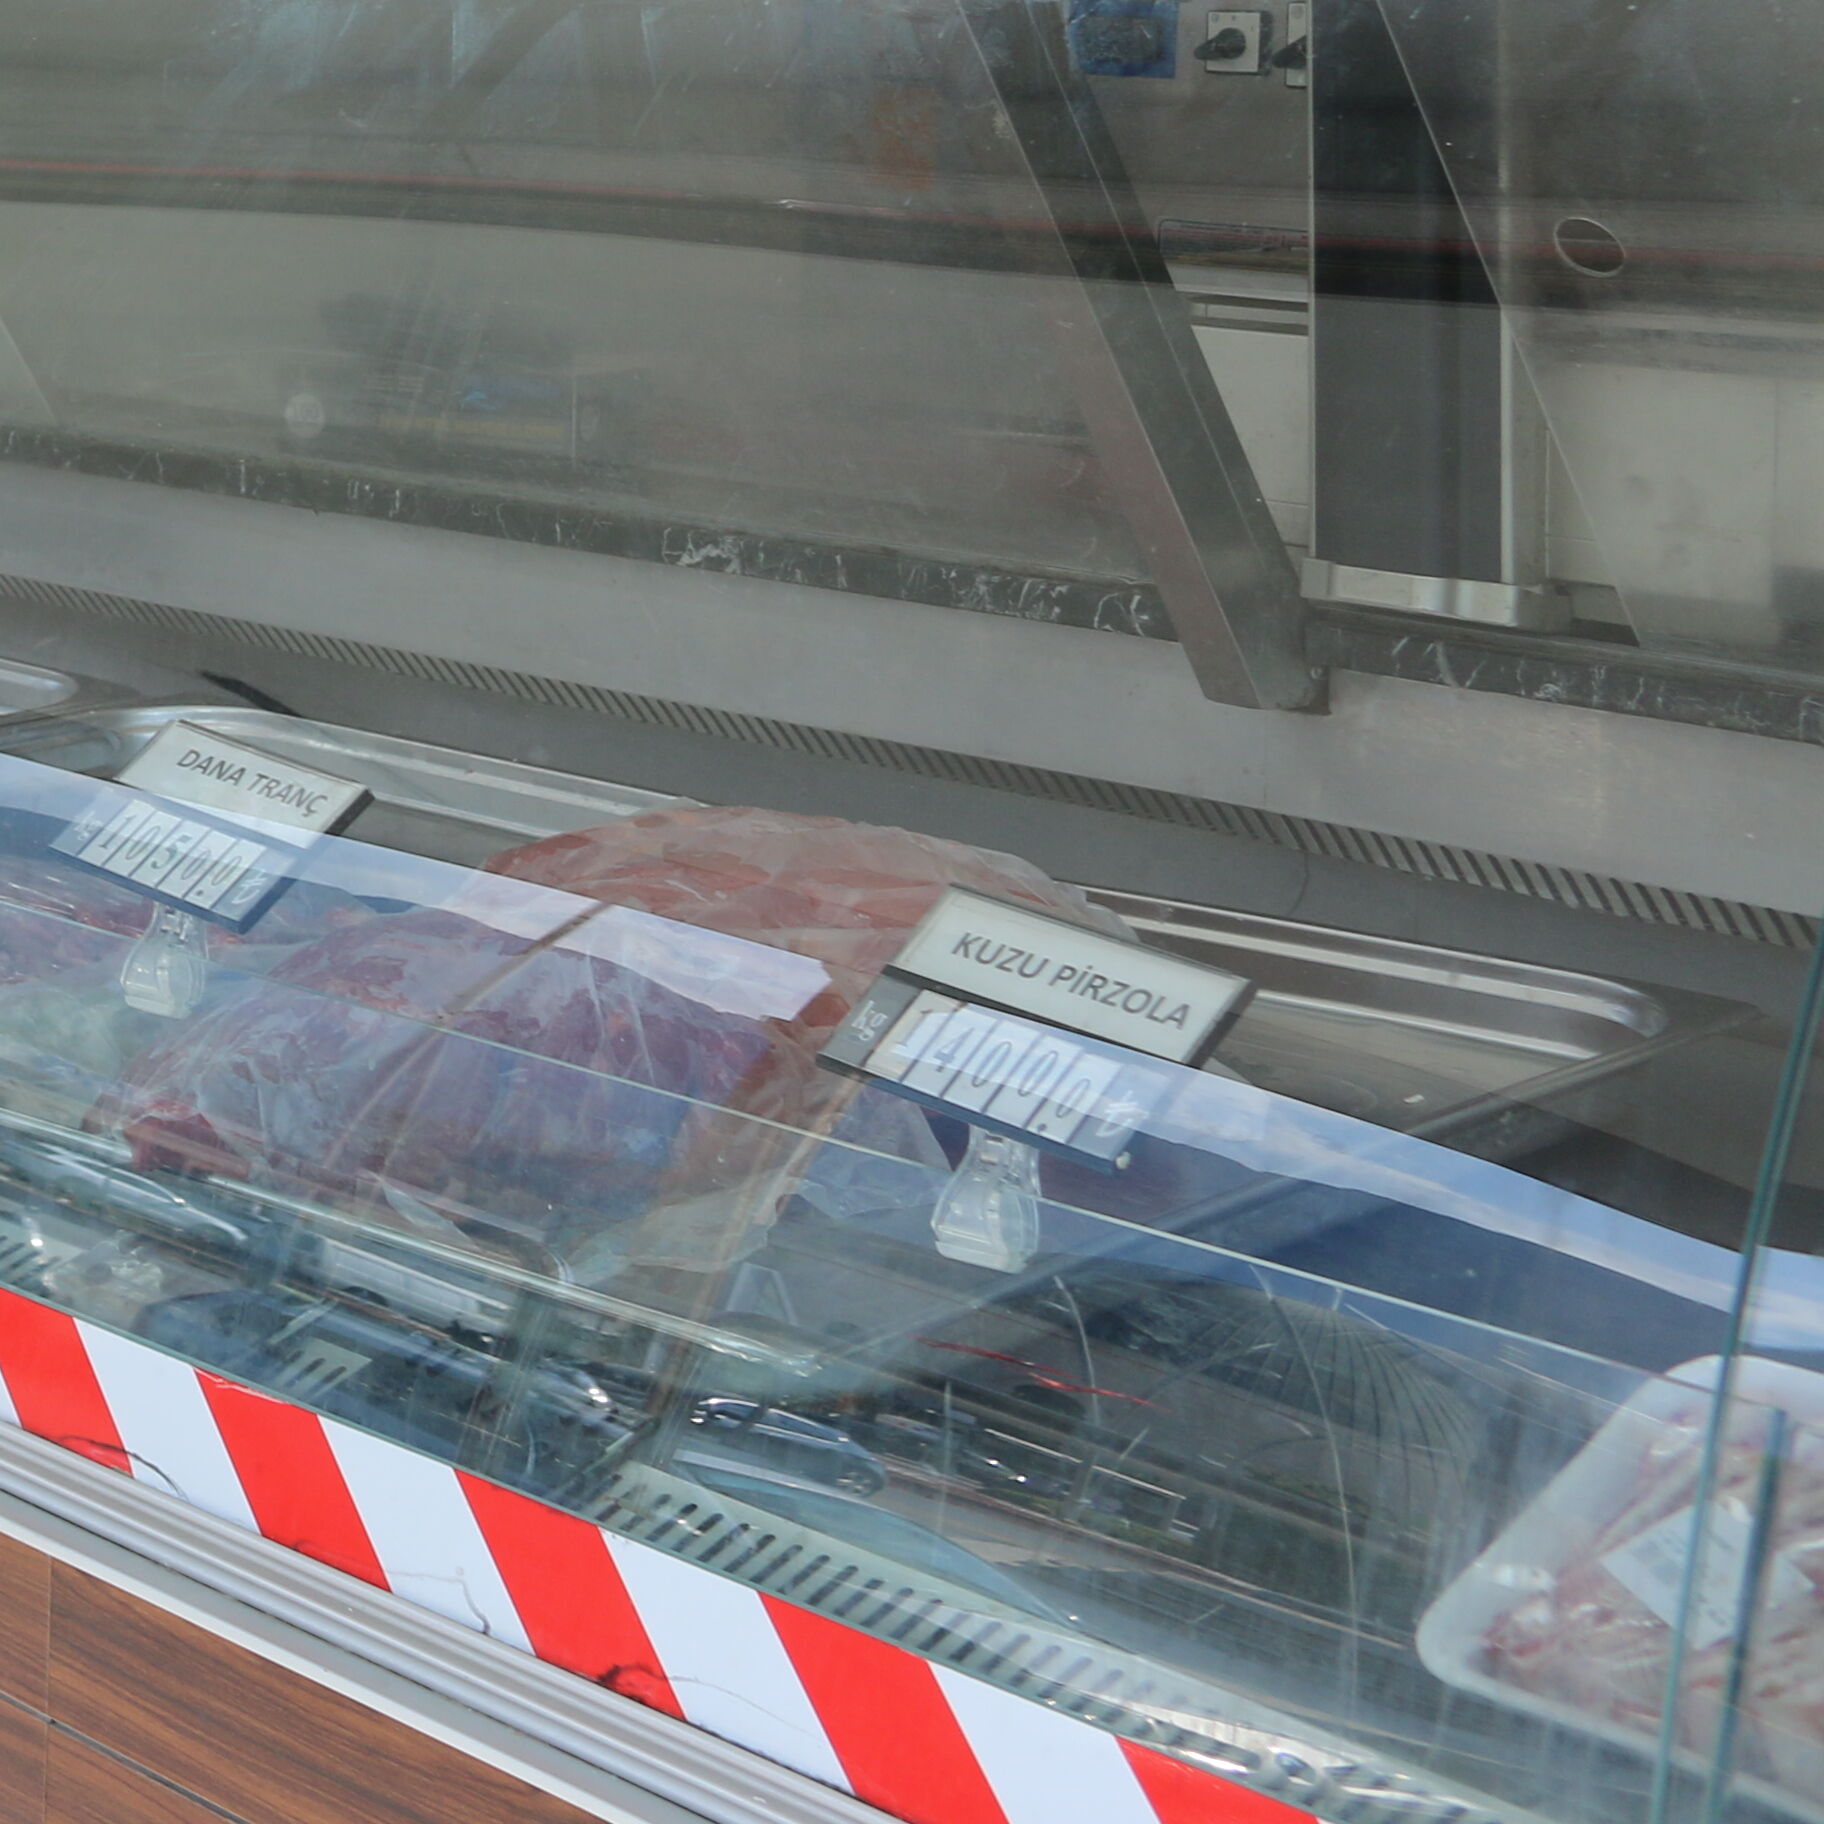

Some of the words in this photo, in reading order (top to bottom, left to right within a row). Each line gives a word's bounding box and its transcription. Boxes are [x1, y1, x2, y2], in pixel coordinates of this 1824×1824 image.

[176, 748, 244, 785] DANA
[245, 772, 329, 819] TRANÇ
[950, 931, 1051, 981] KUZU
[1049, 962, 1192, 1033] PİRZOLA
[851, 999, 890, 1043] kg
